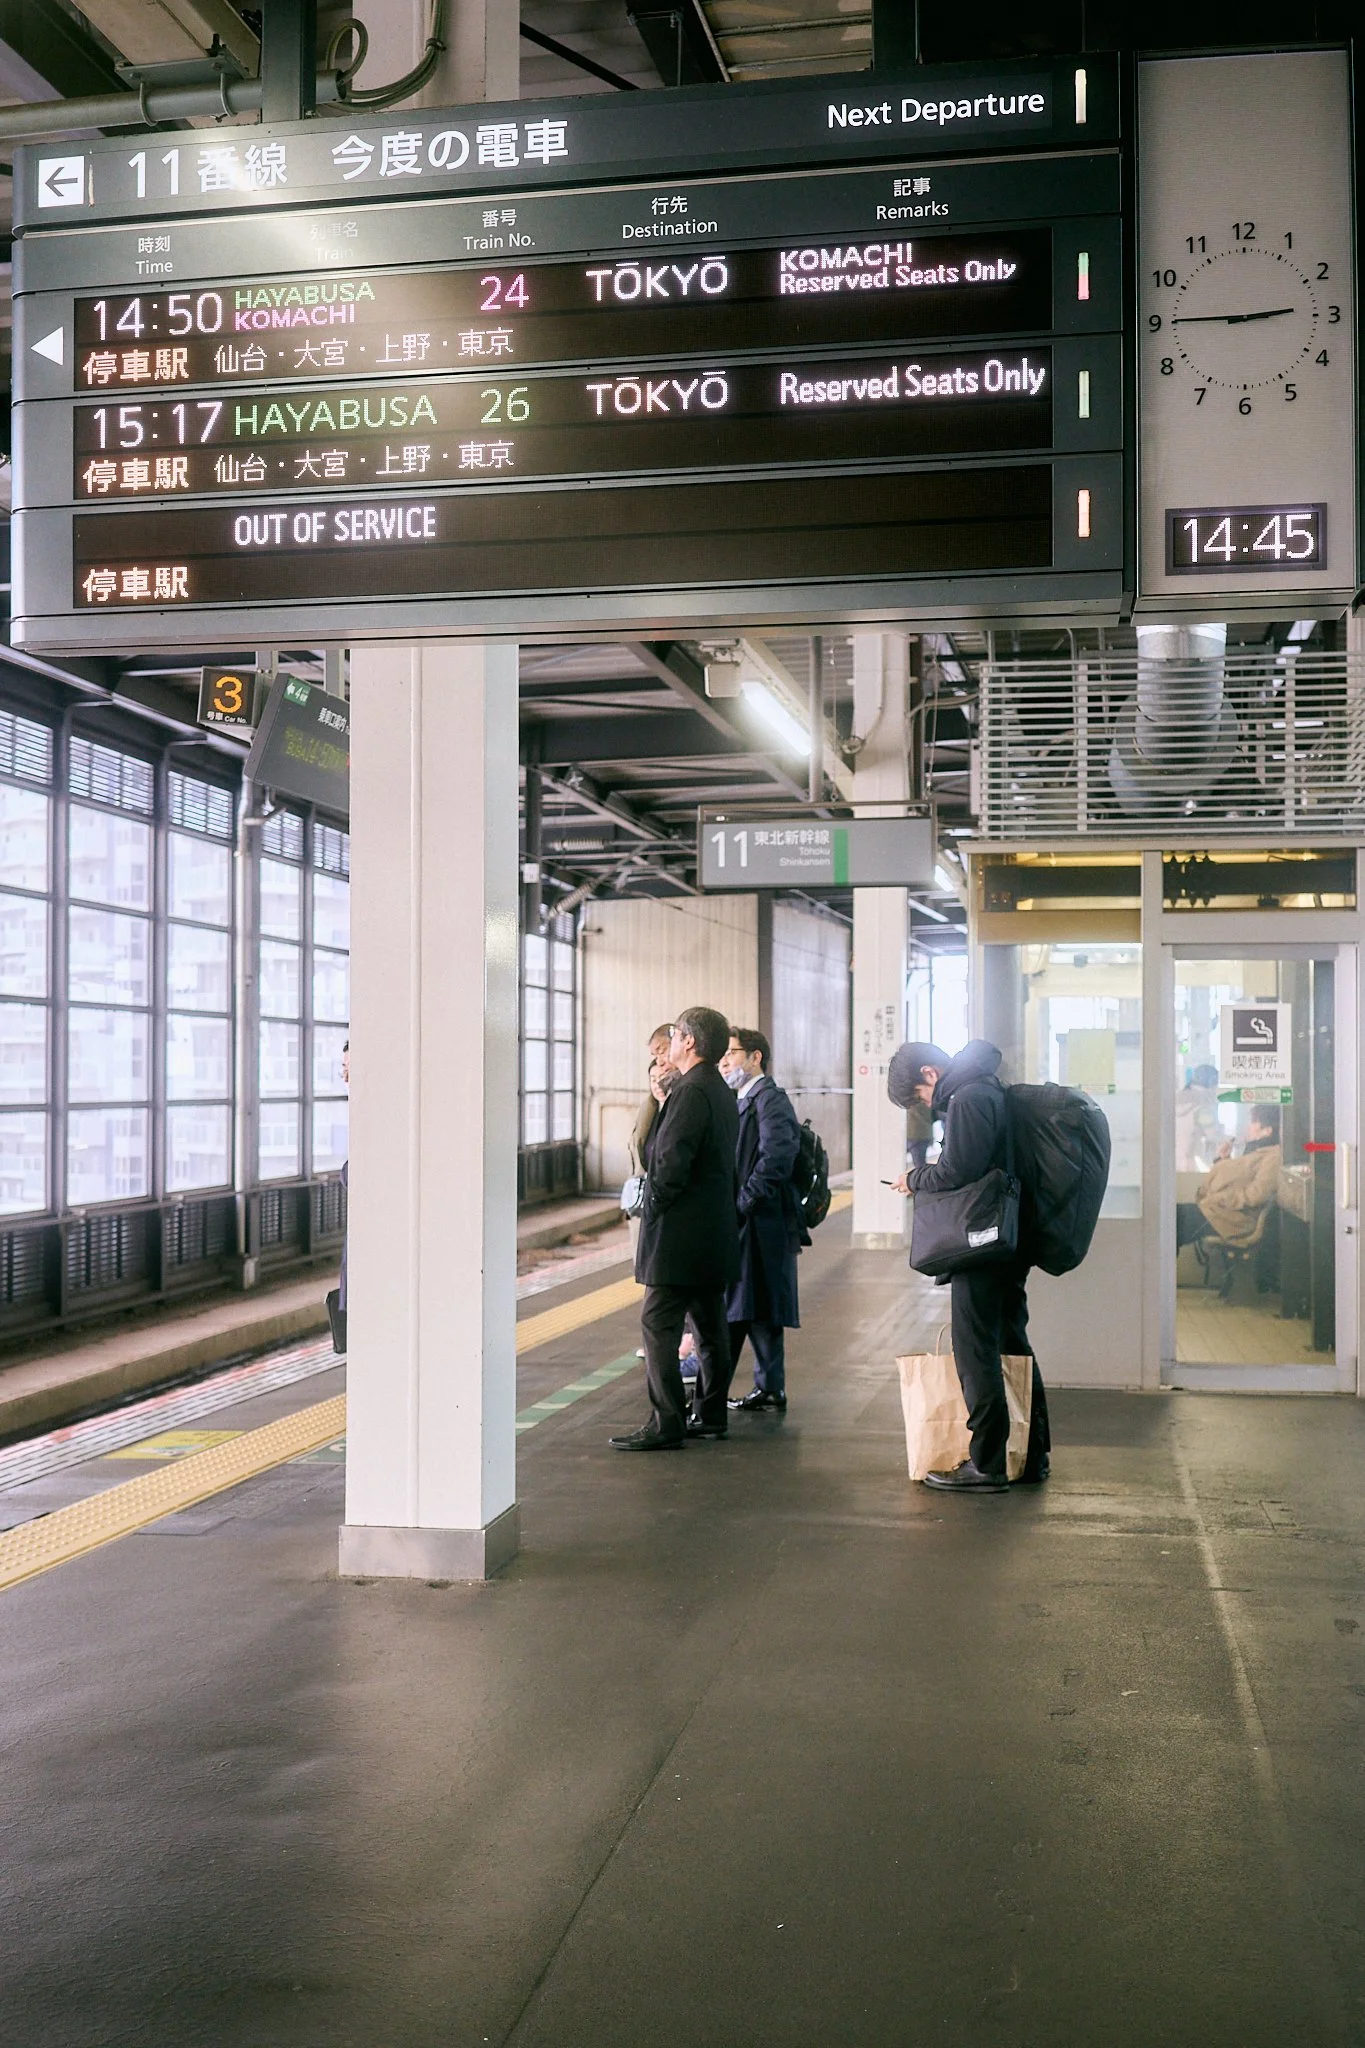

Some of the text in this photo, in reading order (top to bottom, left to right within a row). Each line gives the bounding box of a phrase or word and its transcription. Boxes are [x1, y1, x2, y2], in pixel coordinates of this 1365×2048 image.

[828, 92, 1045, 128] Next Departure
[128, 118, 569, 198] 11番線 今度の電車
[893, 177, 931, 198] 記事
[651, 196, 688, 215] 行先
[876, 201, 949, 220] Remarks
[482, 208, 517, 228] 番号
[622, 218, 718, 239] Destination
[1232, 222, 1256, 240] 12
[137, 235, 170, 254] 時刻
[463, 232, 536, 251] Train No.
[1185, 235, 1206, 254] 11
[1284, 232, 1292, 249] 1
[135, 257, 173, 275] Time
[780, 243, 913, 272] KOMACHI
[585, 256, 729, 301] TŌKYŌ
[780, 258, 1017, 295] Reserved Seats Only
[1152, 269, 1176, 287] 10
[1316, 262, 1329, 280] 2
[235, 282, 376, 309] HAYABUSA
[480, 273, 529, 311] 24
[93, 292, 223, 340] 14:50
[234, 303, 356, 331] KOMACHI
[1149, 315, 1162, 332] 9
[1328, 305, 1340, 323] 3
[82, 347, 189, 385] 停車駅
[1160, 357, 1174, 375] 8
[1315, 349, 1329, 366] 4
[780, 358, 1046, 405] Reserved Seats Only
[585, 370, 729, 416] TŌKYŌ
[1194, 387, 1206, 405] 7
[1285, 384, 1297, 401] 5
[234, 395, 437, 436] HAYABUSA
[480, 387, 530, 424] 26
[1238, 397, 1251, 415] 6
[93, 401, 223, 449] 15:17
[82, 456, 189, 494] 停車駅
[234, 506, 436, 546] OUT OF SERVICE
[1183, 513, 1314, 563] 14:45
[82, 566, 189, 603] 停車駅
[213, 676, 243, 713] 3
[224, 715, 236, 723] Car
[237, 716, 247, 724] No.
[754, 829, 830, 846] 東北新幹線
[711, 831, 748, 868] 11
[779, 857, 831, 868] Shinkansen
[1231, 1054, 1278, 1070] 喫煙所
[1225, 1070, 1286, 1081] Smoking Area
